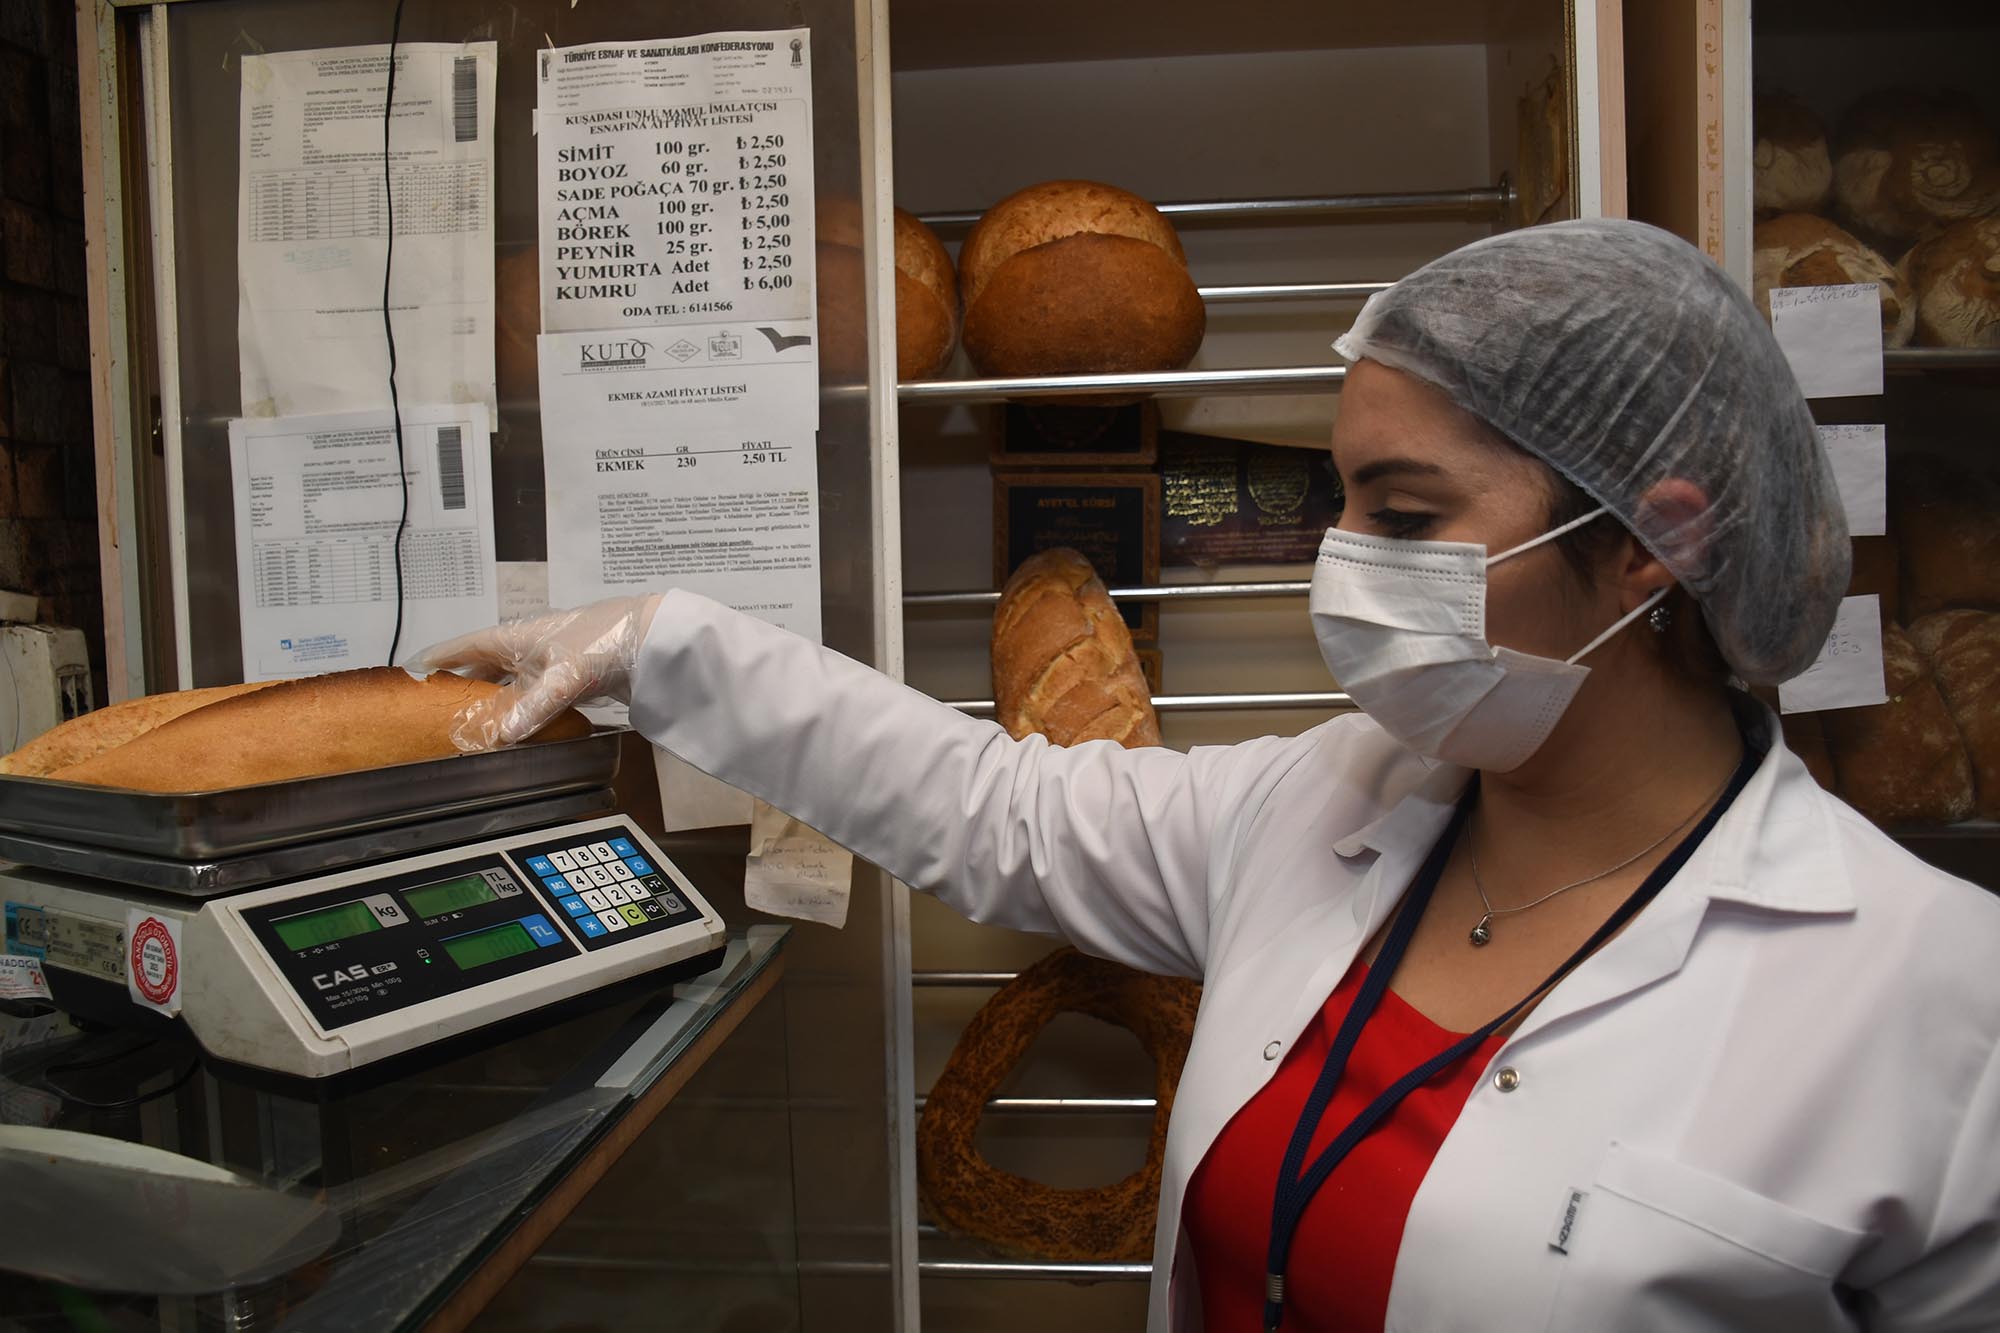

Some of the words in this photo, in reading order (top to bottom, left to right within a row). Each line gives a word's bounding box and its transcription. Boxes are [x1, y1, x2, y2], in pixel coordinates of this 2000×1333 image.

[564, 50, 596, 63] TÜRKİYE
[598, 49, 624, 59] ESNAF
[627, 49, 637, 58] VE
[640, 45, 699, 58] SANATKÂRLARI
[701, 42, 774, 53] KONFEDERASYONU
[566, 111, 623, 126] KUŞADASI
[709, 102, 777, 114] İMALATÇISI
[711, 114, 753, 126] LİSTESİ
[558, 143, 615, 163] SİMİT
[656, 141, 682, 155] 100
[688, 143, 710, 157] gr.
[751, 134, 784, 150] 2,50
[559, 163, 628, 182] BOYOZ
[661, 161, 680, 175] 60
[686, 163, 708, 176] gr.
[754, 154, 786, 170] 2,50
[557, 187, 605, 201] SADE
[611, 181, 683, 198] POĞAÇA
[689, 180, 708, 193] 70
[712, 182, 734, 195] gr.
[754, 174, 787, 190] 2,50
[557, 205, 620, 222] AÇMA
[658, 201, 686, 214] 100
[691, 202, 714, 216] gr.
[756, 194, 789, 210] 2,50
[558, 223, 630, 241] BÖREK
[657, 221, 685, 234] 100
[689, 222, 713, 236] gr.
[757, 214, 790, 230] 5,00
[557, 243, 636, 261] PEYNİR
[666, 241, 685, 254] 25
[690, 242, 713, 257] gr.
[757, 234, 791, 250] 2,50
[557, 262, 662, 280] YUMURTA
[671, 260, 710, 274] Adet
[758, 254, 792, 270] 2,50
[557, 283, 637, 300] KUMRU
[671, 280, 710, 295] Adet
[758, 274, 793, 291] 6,00
[623, 306, 652, 317] ODA
[655, 305, 680, 316] TEL
[689, 301, 733, 313] 6141566
[581, 340, 647, 361] KUTO
[608, 390, 643, 402] EKMEK
[645, 388, 677, 399] AZAMİ
[679, 386, 708, 397] FİYAT
[710, 384, 747, 395] LİSTESİ
[595, 448, 618, 458] ÜRÜN
[620, 447, 644, 456] CİNSİ
[676, 445, 689, 454] GR
[742, 441, 771, 450] FİYATI
[597, 460, 645, 472] EKMEK
[677, 456, 697, 468] 230
[743, 453, 766, 465] 2,50
[768, 452, 787, 463] TL
[535, 861, 550, 870] M1
[557, 856, 568, 866] 7
[580, 851, 589, 862] 8
[598, 846, 609, 857] 9
[486, 872, 506, 882] TL
[550, 881, 566, 890] M2
[576, 875, 585, 886] 4
[594, 870, 605, 881] 5
[615, 865, 625, 876] 6
[496, 882, 517, 893] /kg
[591, 895, 602, 905] 1
[611, 889, 623, 900] 2
[630, 884, 641, 895] 3
[375, 905, 398, 918] kg
[567, 900, 583, 910] M3
[424, 918, 438, 927] SUM
[607, 915, 618, 926] 0
[627, 909, 640, 920] C
[530, 924, 553, 938] TL
[325, 943, 341, 951] NET
[312, 964, 370, 990] CAS
[325, 994, 340, 1002] Max
[371, 981, 384, 989] Min
[385, 976, 402, 986] 100g
